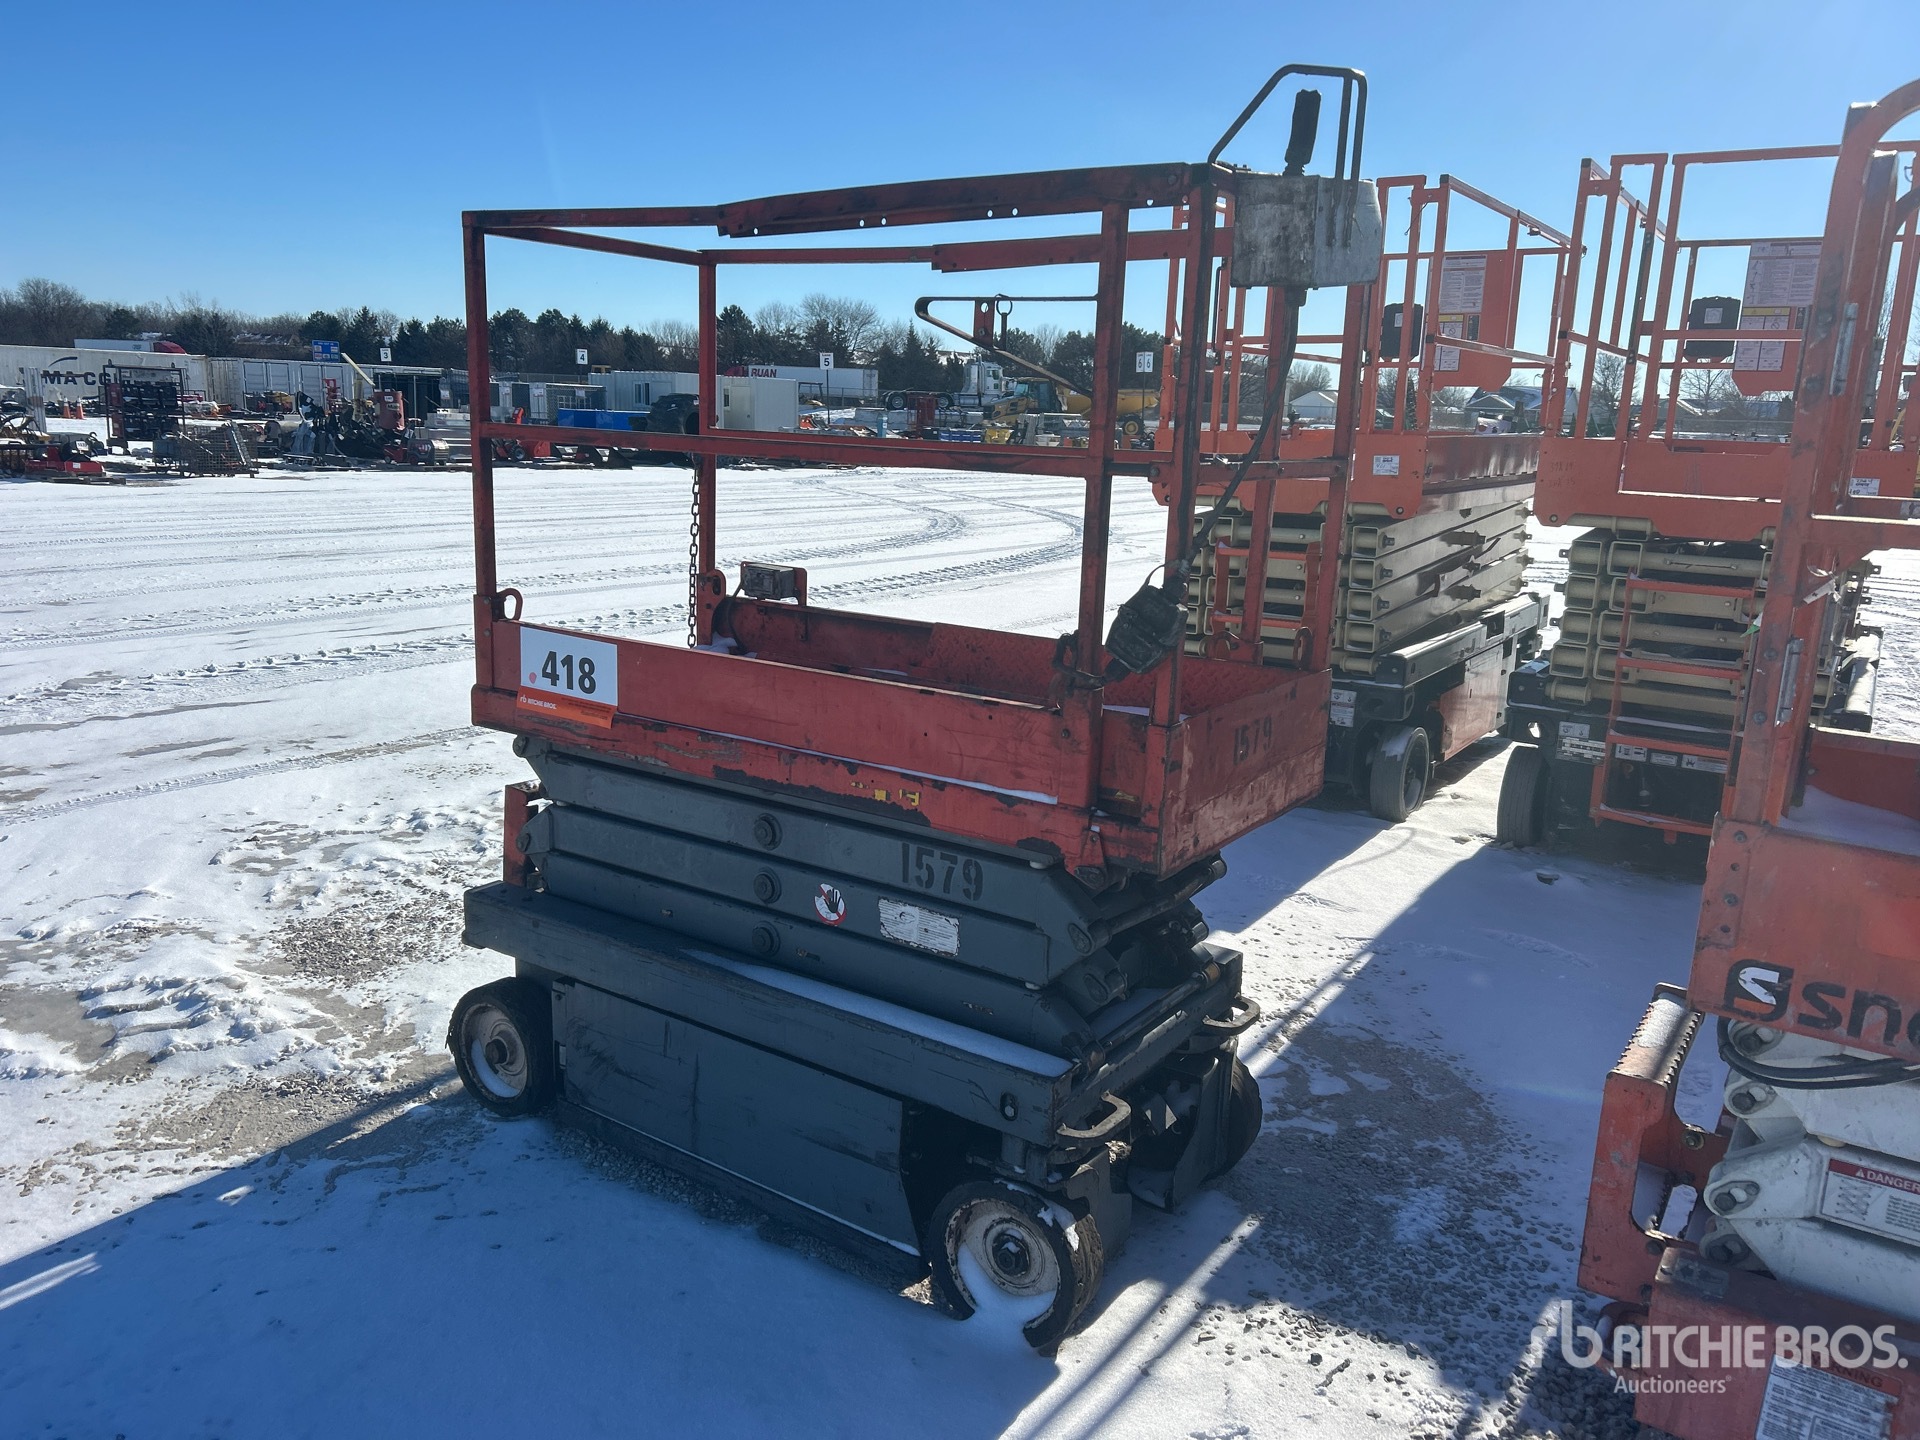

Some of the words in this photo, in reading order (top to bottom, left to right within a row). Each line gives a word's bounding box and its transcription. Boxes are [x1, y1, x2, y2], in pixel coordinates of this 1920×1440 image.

[823, 358, 830, 367] 5
[1138, 358, 1143, 368] 6
[1147, 358, 1151, 368] 6
[751, 368, 777, 378] RUAN
[541, 650, 597, 695] 418
[901, 842, 983, 900] 1579
[1797, 981, 1920, 1048] sn
[1867, 1170, 1920, 1194] DANGER
